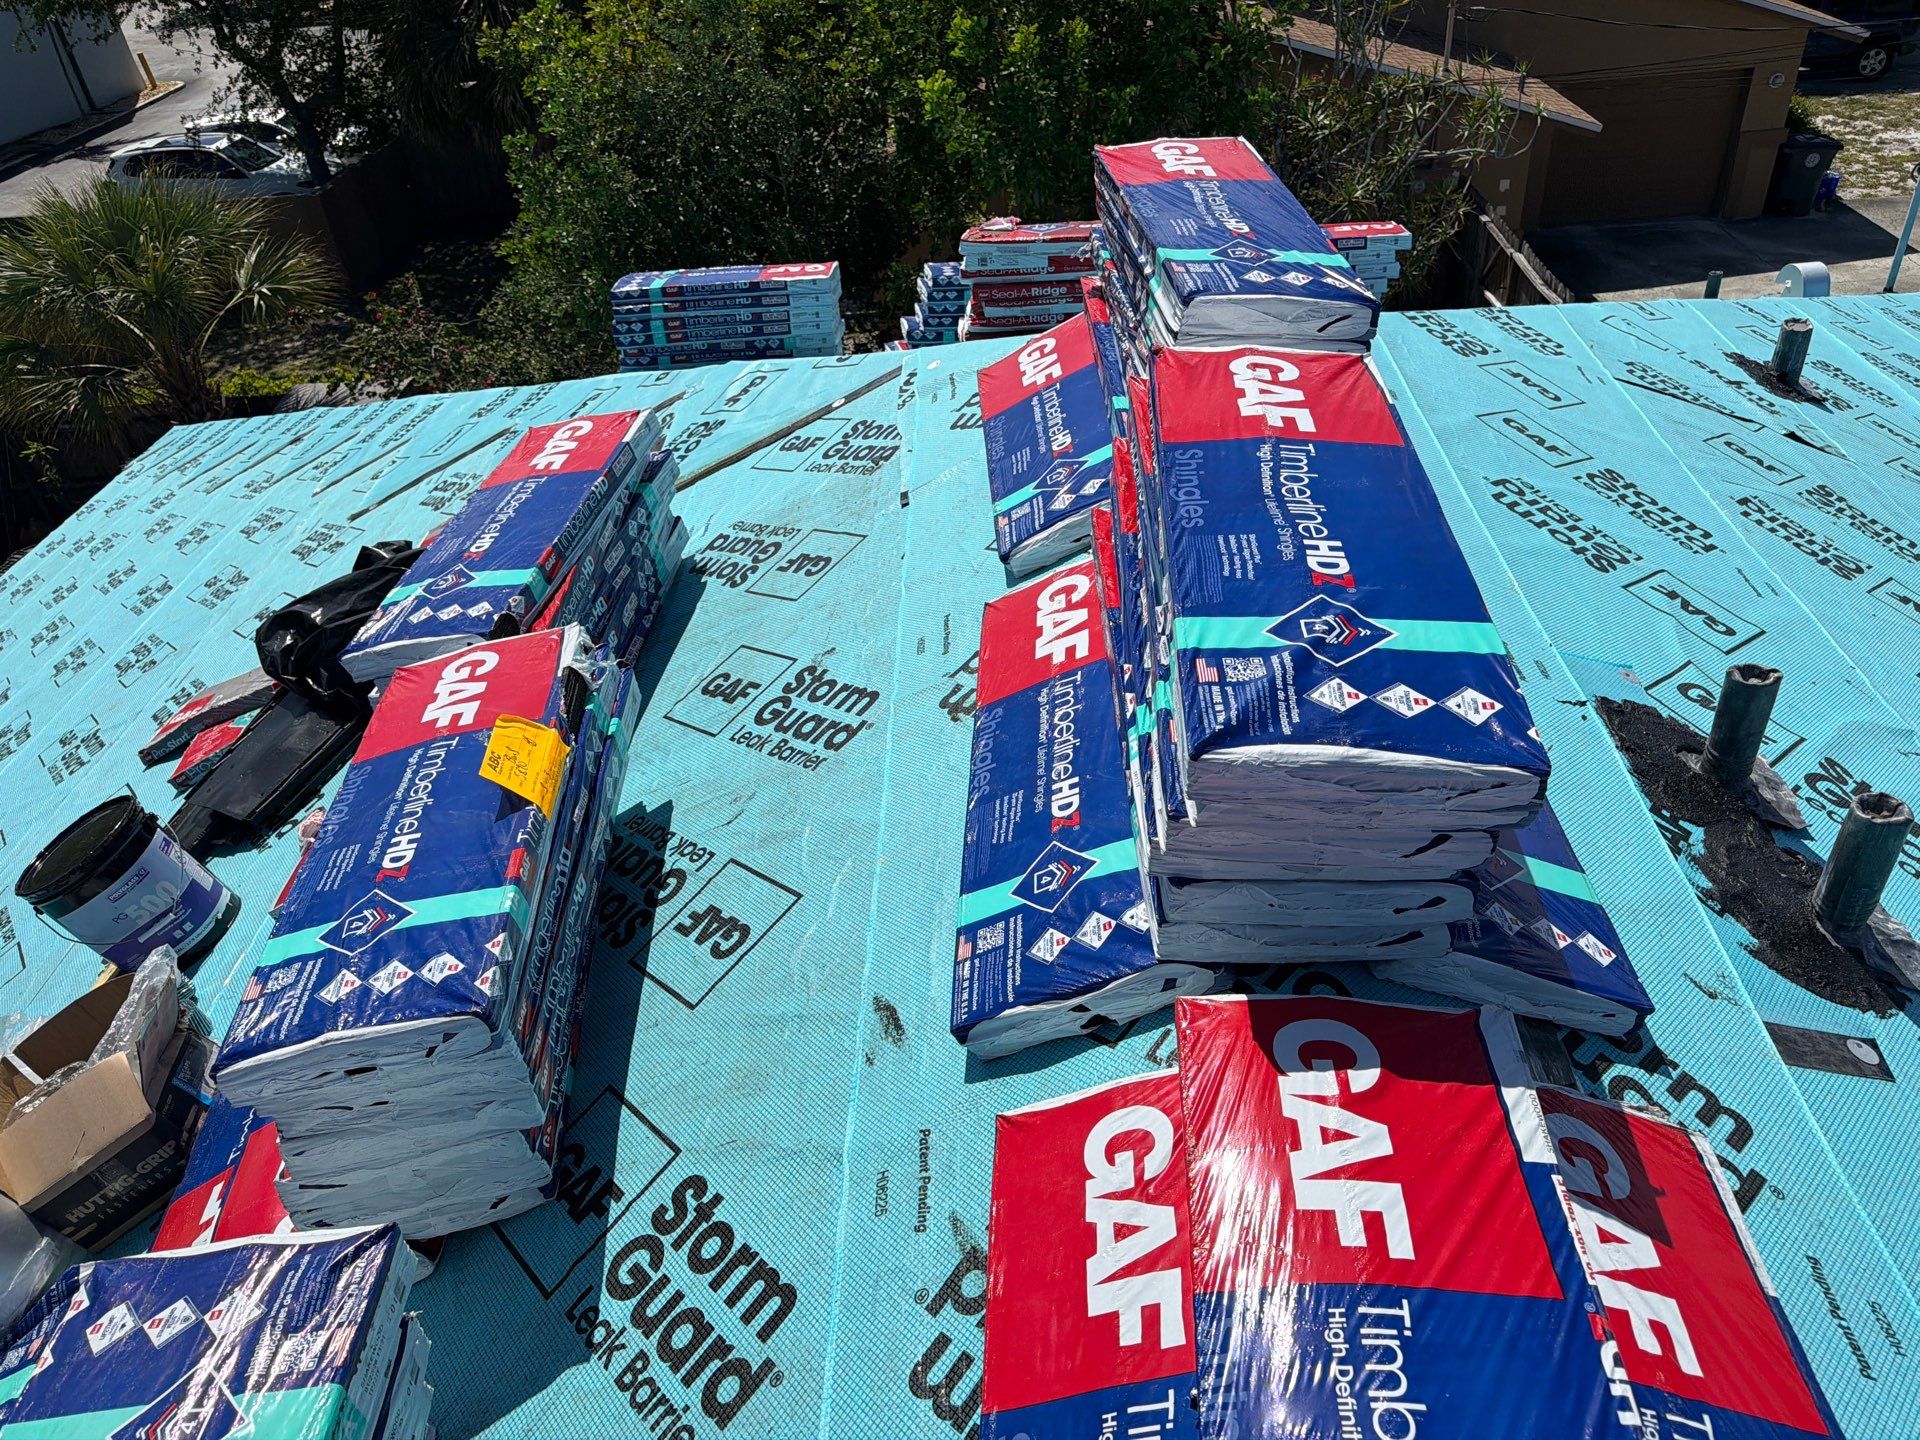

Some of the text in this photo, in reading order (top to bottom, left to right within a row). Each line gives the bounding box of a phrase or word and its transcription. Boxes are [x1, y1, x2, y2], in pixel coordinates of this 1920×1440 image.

[1151, 141, 1217, 177] GAF
[766, 263, 827, 273] GAF
[991, 285, 1067, 299] Seal-A-Ridge
[990, 312, 1065, 325] Seal-A-Ridge
[1017, 338, 1062, 388] GAF
[1501, 368, 1562, 402] GAF
[1228, 356, 1316, 433] GAF
[529, 420, 594, 470] GAF
[780, 435, 825, 452] GAF
[1256, 444, 1273, 461] High
[1503, 417, 1572, 457] GAF
[1724, 440, 1788, 476] GAF
[804, 461, 834, 474] Leak
[1169, 449, 1210, 528] Shingles
[1511, 477, 1644, 561] Leak Barrier
[1573, 475, 1704, 555] Leak Barrier
[1597, 468, 1713, 540] Storm
[701, 533, 782, 564] Guard
[768, 527, 802, 542] Leak
[1491, 491, 1617, 574] Storm
[544, 553, 558, 571] GAF
[776, 553, 832, 577] GAF
[1035, 574, 1090, 665] GAF
[1650, 584, 1737, 637] GAF
[421, 651, 499, 728] GAF
[702, 672, 760, 704] GAF
[781, 664, 881, 716] Storm
[1211, 685, 1222, 703] MADE
[487, 751, 501, 773] ABC
[730, 725, 827, 772] Leak Barrier
[624, 813, 716, 874] Leak Barrier
[108, 874, 139, 901] POLYGLASS
[674, 904, 752, 960] GAF
[1272, 1017, 1416, 1261] GAF
[1528, 1092, 1553, 1155] SHAKEWOOD
[97, 1166, 173, 1221] FASTENERS
[874, 1170, 889, 1218] H06225
[914, 1128, 932, 1234] Patent Pending
[1084, 1104, 1186, 1350] GAF
[1544, 1112, 1704, 1378] GAF
[650, 1174, 798, 1344] Storm
[1324, 1307, 1346, 1364] High
[1806, 1255, 1878, 1382] Patent Pending
[564, 1285, 695, 1440] Leak Barrie
